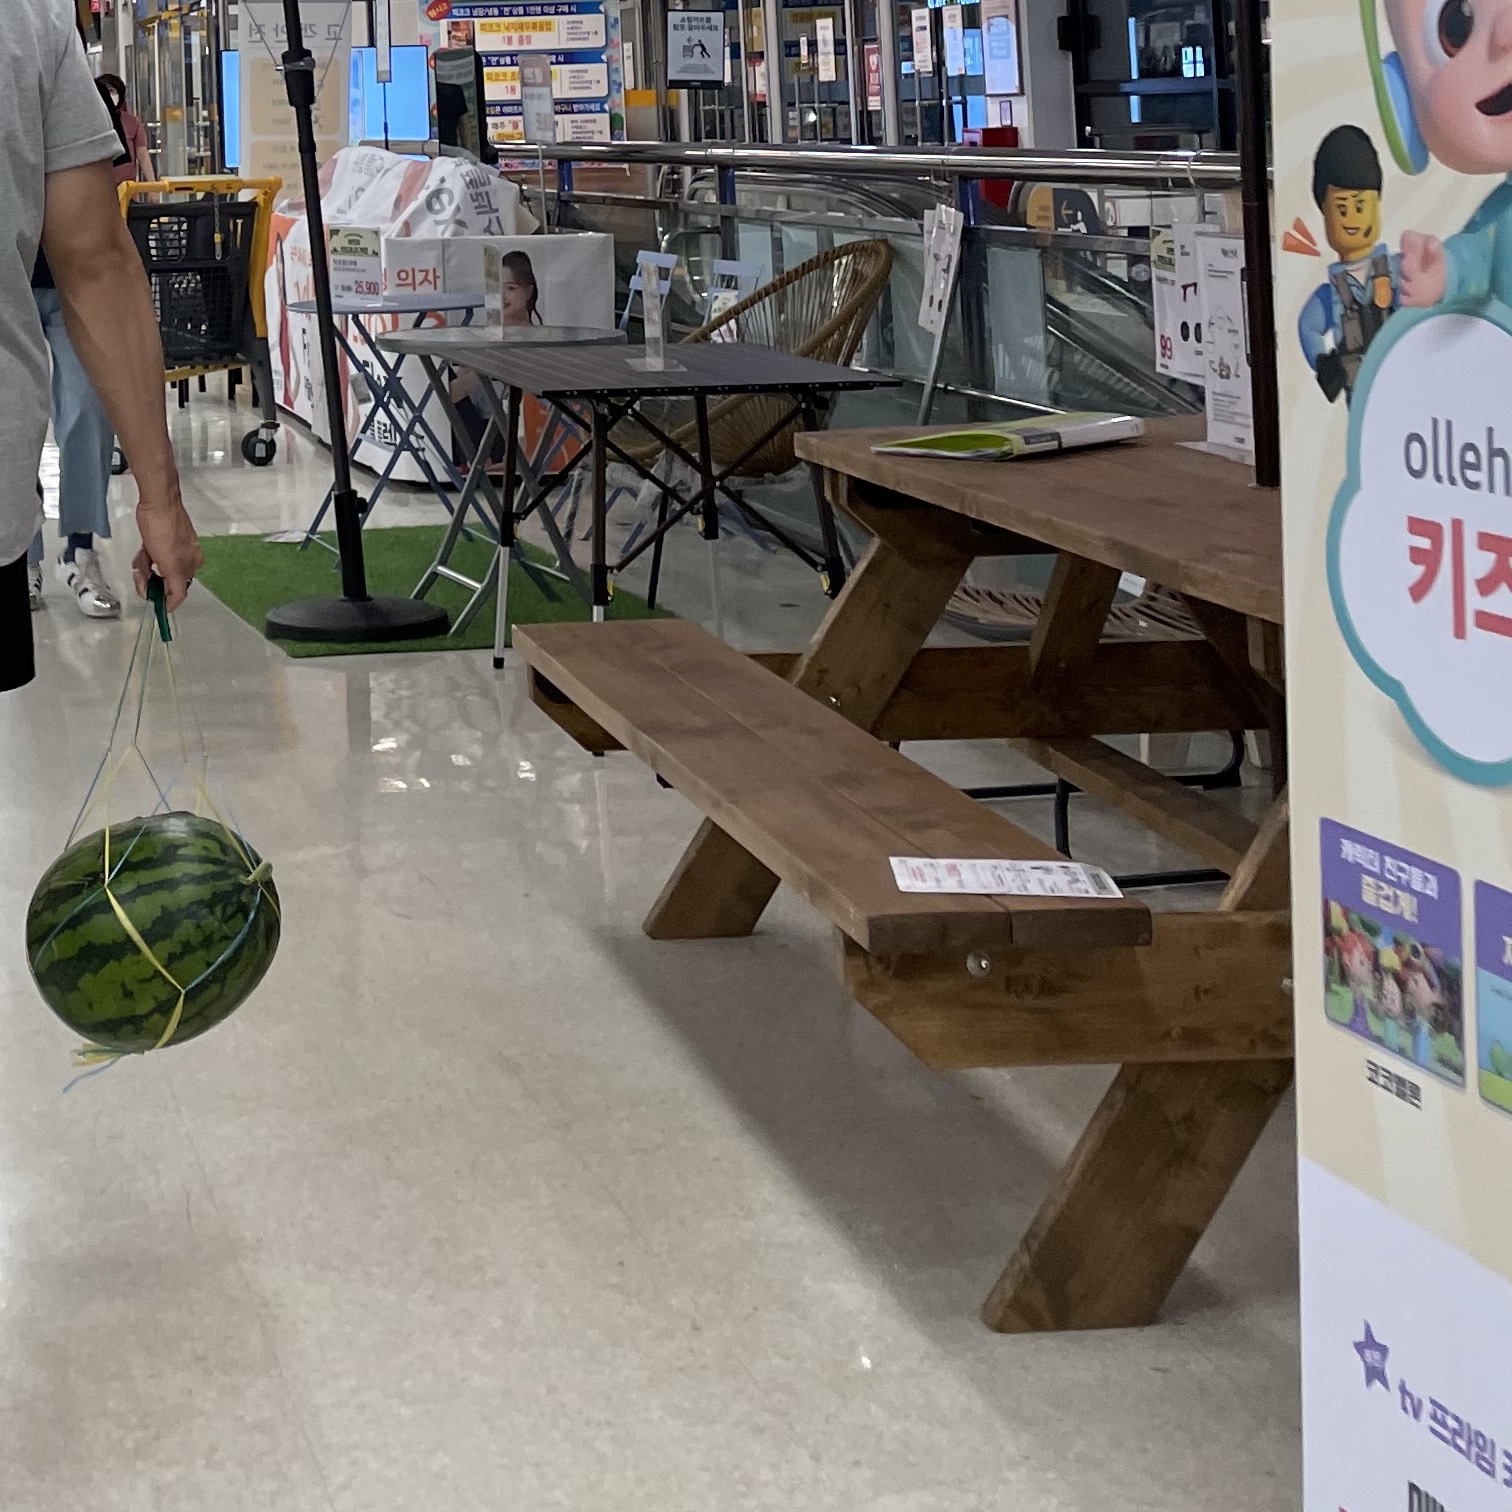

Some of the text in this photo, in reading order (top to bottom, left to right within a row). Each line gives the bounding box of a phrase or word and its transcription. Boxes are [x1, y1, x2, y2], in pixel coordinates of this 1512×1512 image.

[395, 266, 441, 292] 의자
[1404, 416, 1512, 492] olleh
[1398, 1378, 1497, 1479] tv 프라임
